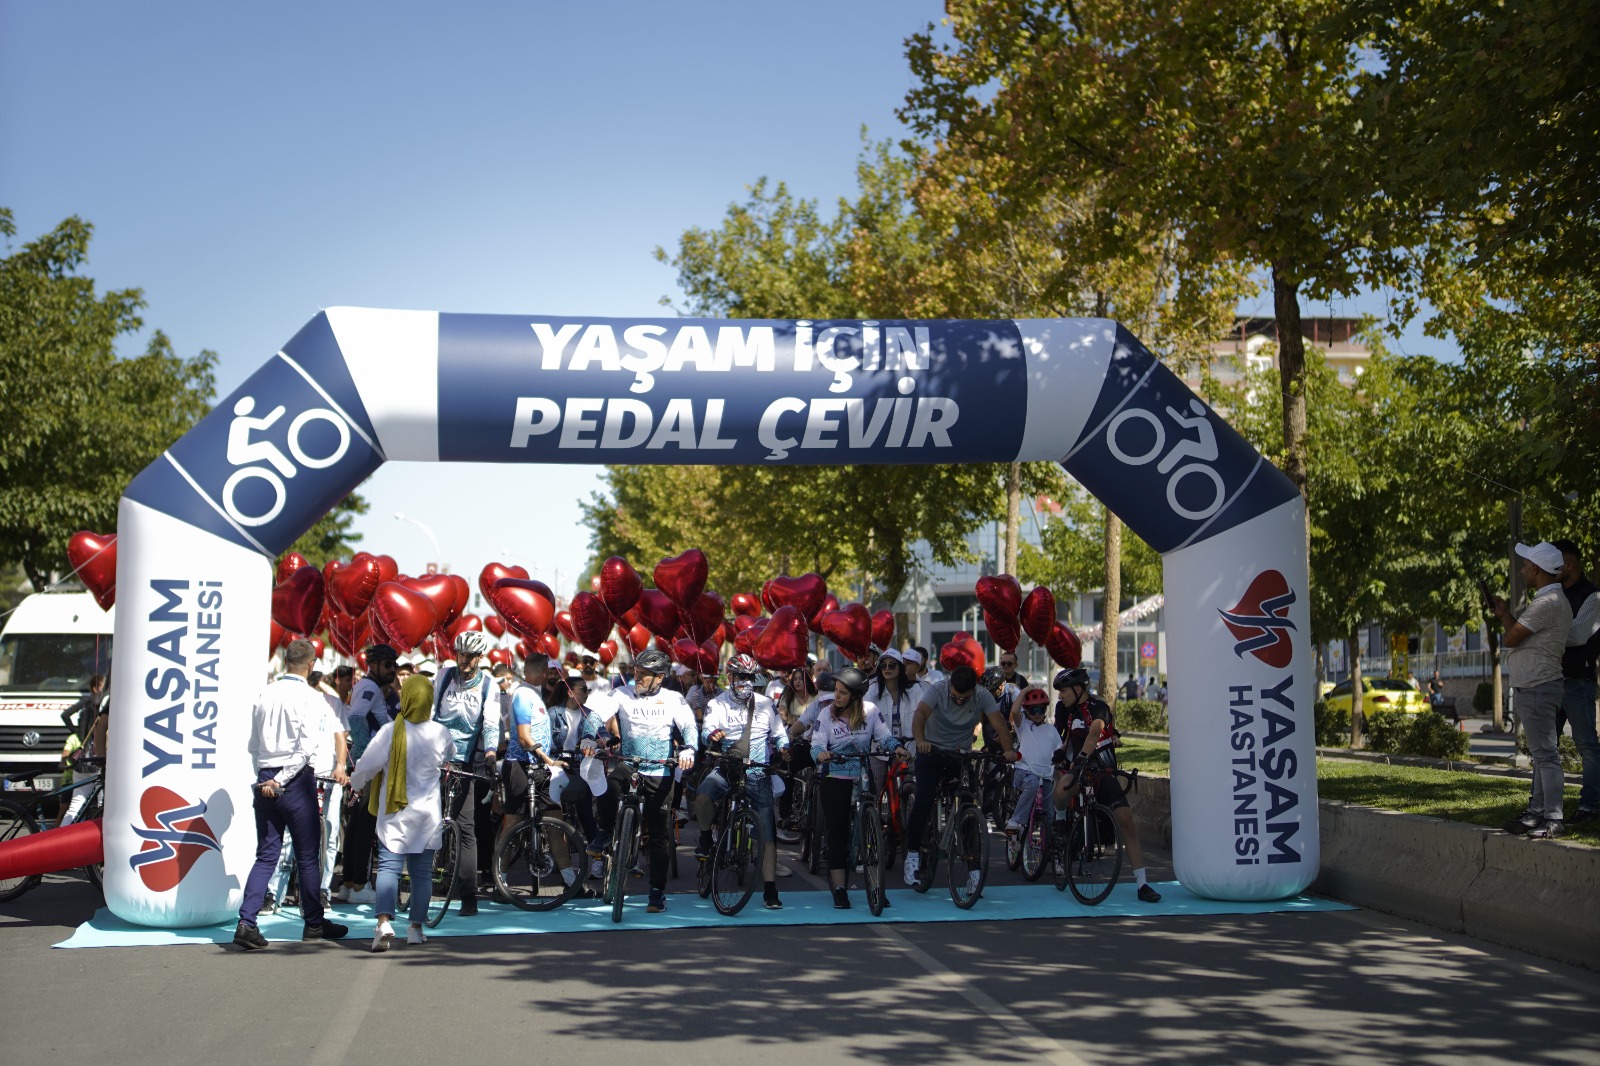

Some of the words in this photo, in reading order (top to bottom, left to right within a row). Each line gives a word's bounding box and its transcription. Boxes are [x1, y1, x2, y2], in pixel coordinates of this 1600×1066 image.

[531, 323, 776, 394] YAŞAM
[793, 320, 931, 394] İÇİN
[510, 397, 737, 450] PEDAL
[757, 375, 960, 461] ÇEVİR
[142, 579, 191, 779] YAŞAM
[38, 780, 52, 788] 155
[1258, 673, 1302, 866] YAŞAM
